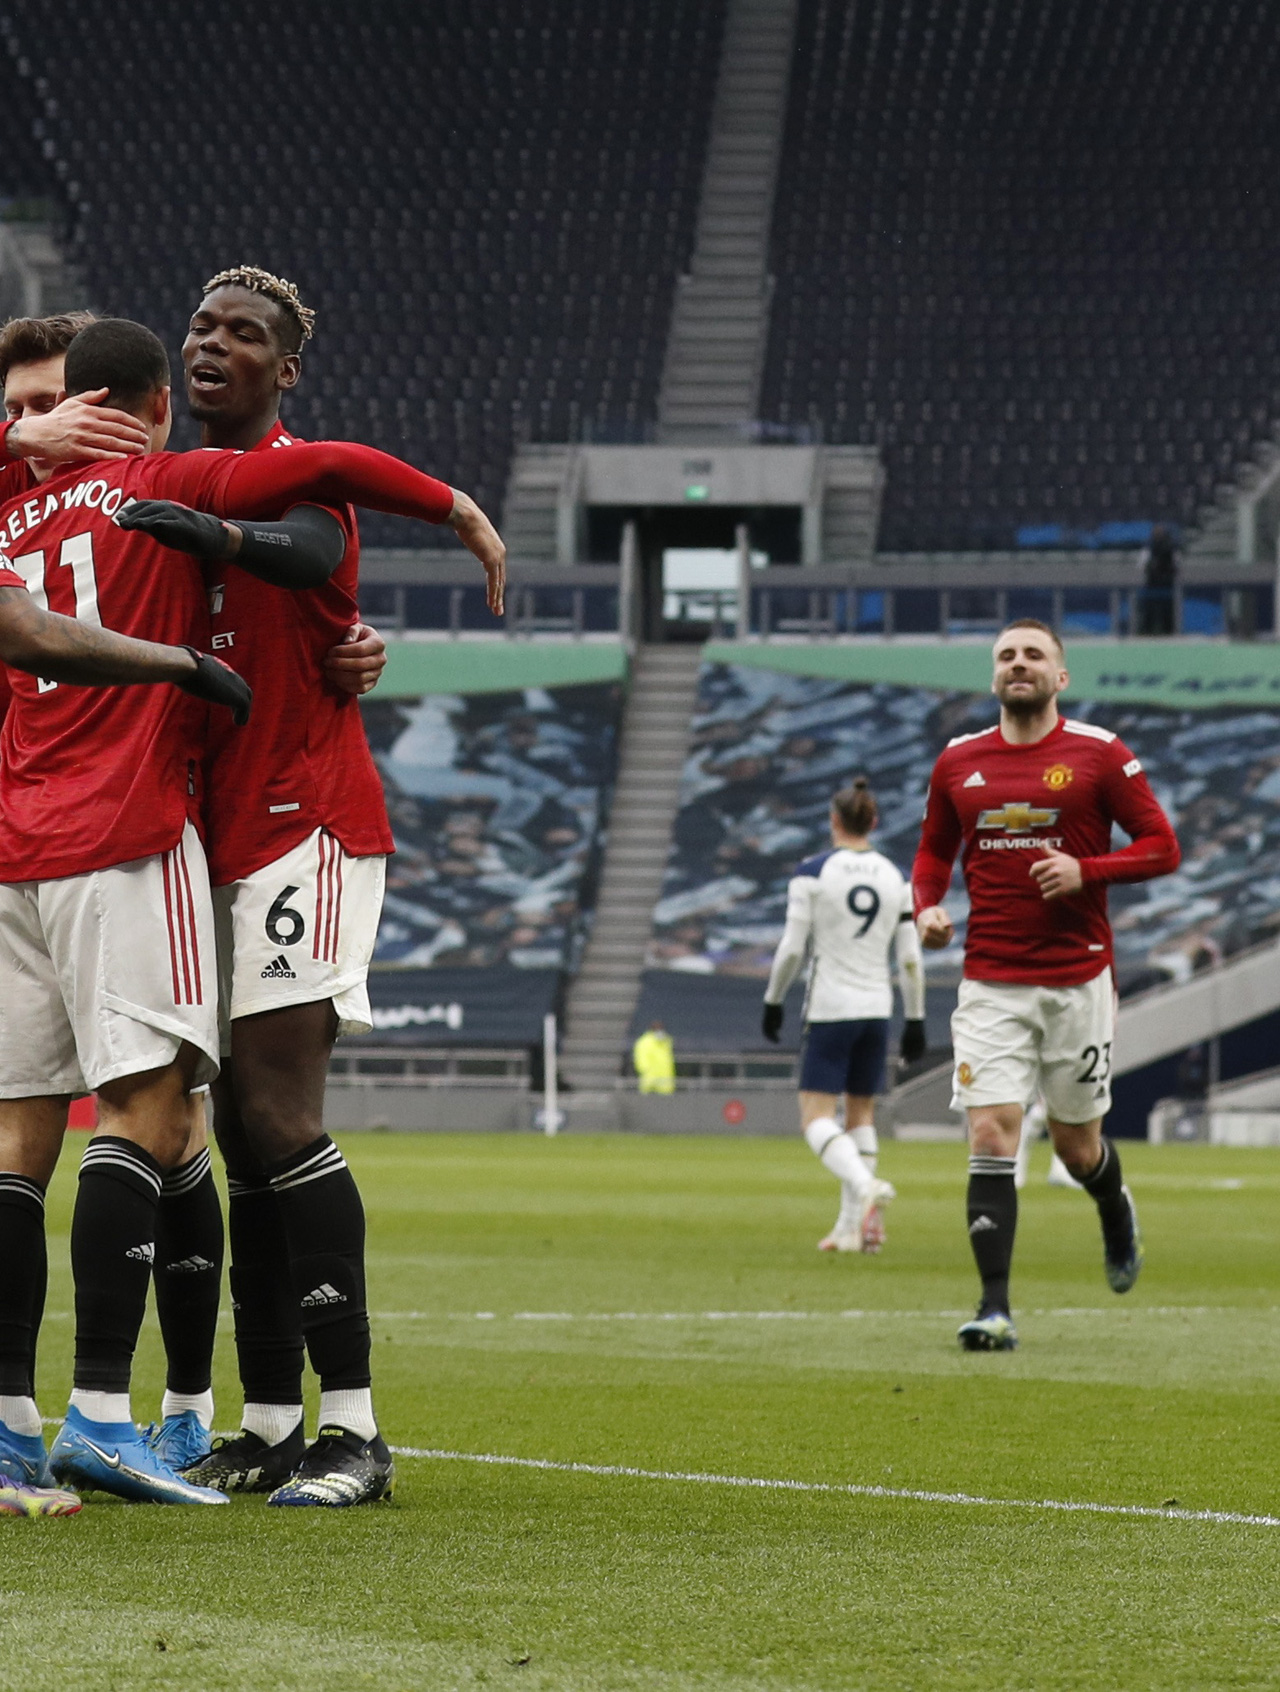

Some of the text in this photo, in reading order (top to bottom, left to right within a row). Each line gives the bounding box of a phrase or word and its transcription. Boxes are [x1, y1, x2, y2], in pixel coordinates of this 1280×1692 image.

[265, 885, 305, 946] 6
[846, 885, 880, 939] 9
[261, 966, 296, 979] adidas
[1076, 1041, 1111, 1083] 23
